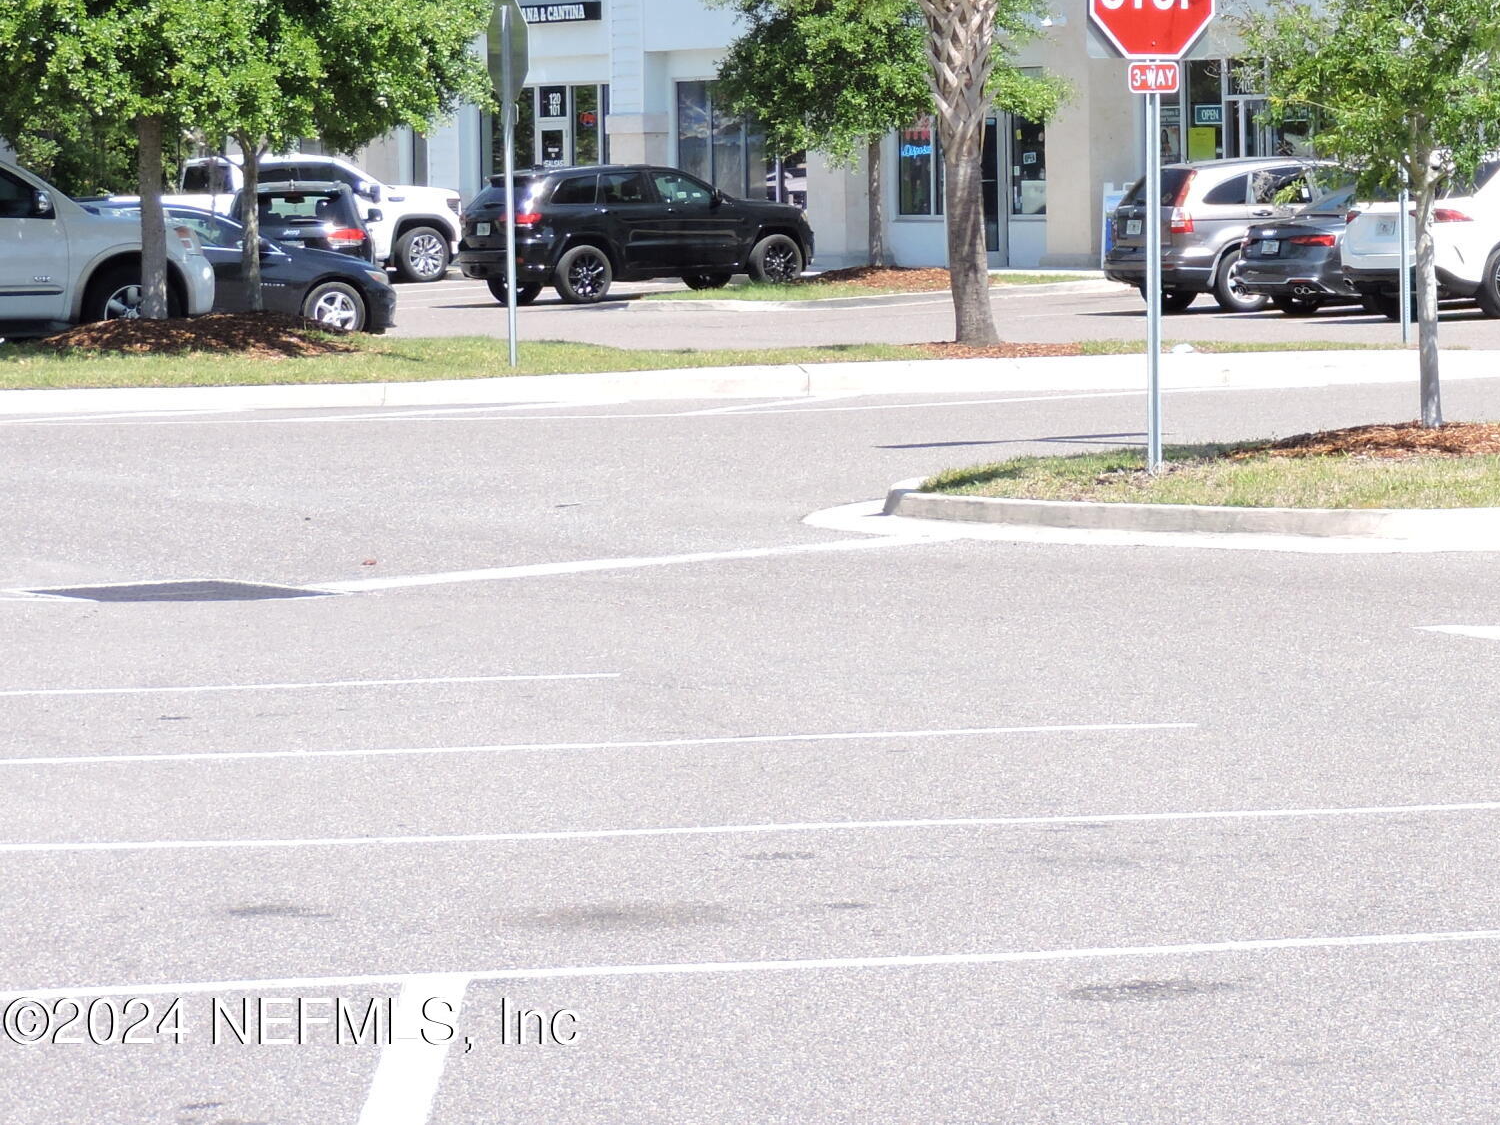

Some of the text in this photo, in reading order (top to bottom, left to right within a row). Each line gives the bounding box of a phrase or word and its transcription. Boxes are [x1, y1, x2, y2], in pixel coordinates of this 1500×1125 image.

[521, 4, 586, 23] ANA & CANTINA
[1132, 68, 1175, 88] 3-WAY
[548, 92, 562, 104] 120
[548, 104, 561, 116] 101
[1201, 109, 1219, 121] OPEN
